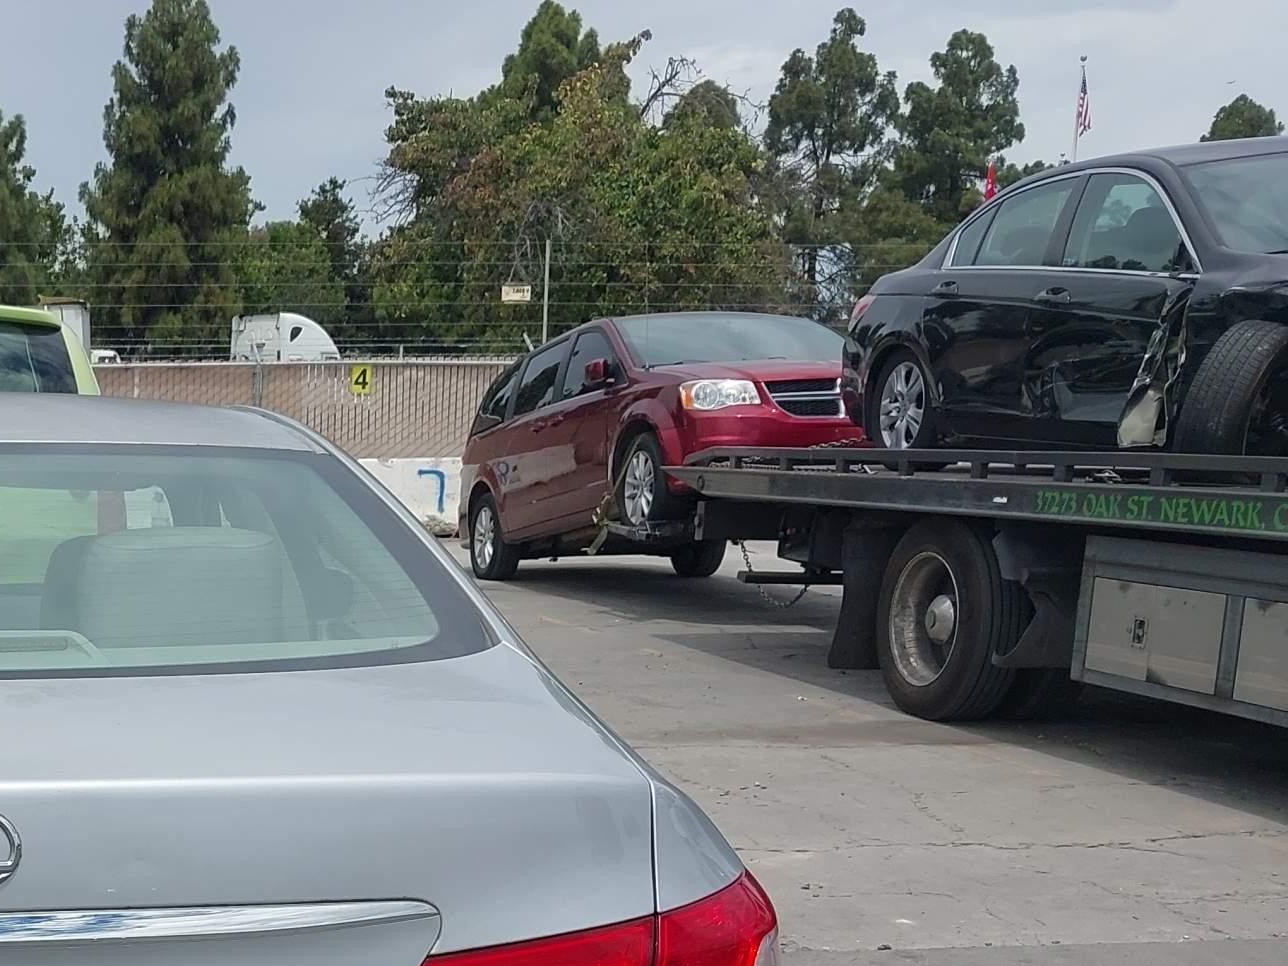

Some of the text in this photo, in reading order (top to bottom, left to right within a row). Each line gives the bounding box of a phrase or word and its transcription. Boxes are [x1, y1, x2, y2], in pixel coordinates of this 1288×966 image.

[354, 368, 369, 390] 4
[1034, 490, 1077, 513] 37273
[1083, 493, 1121, 519] OAK
[1126, 495, 1153, 520] ST.
